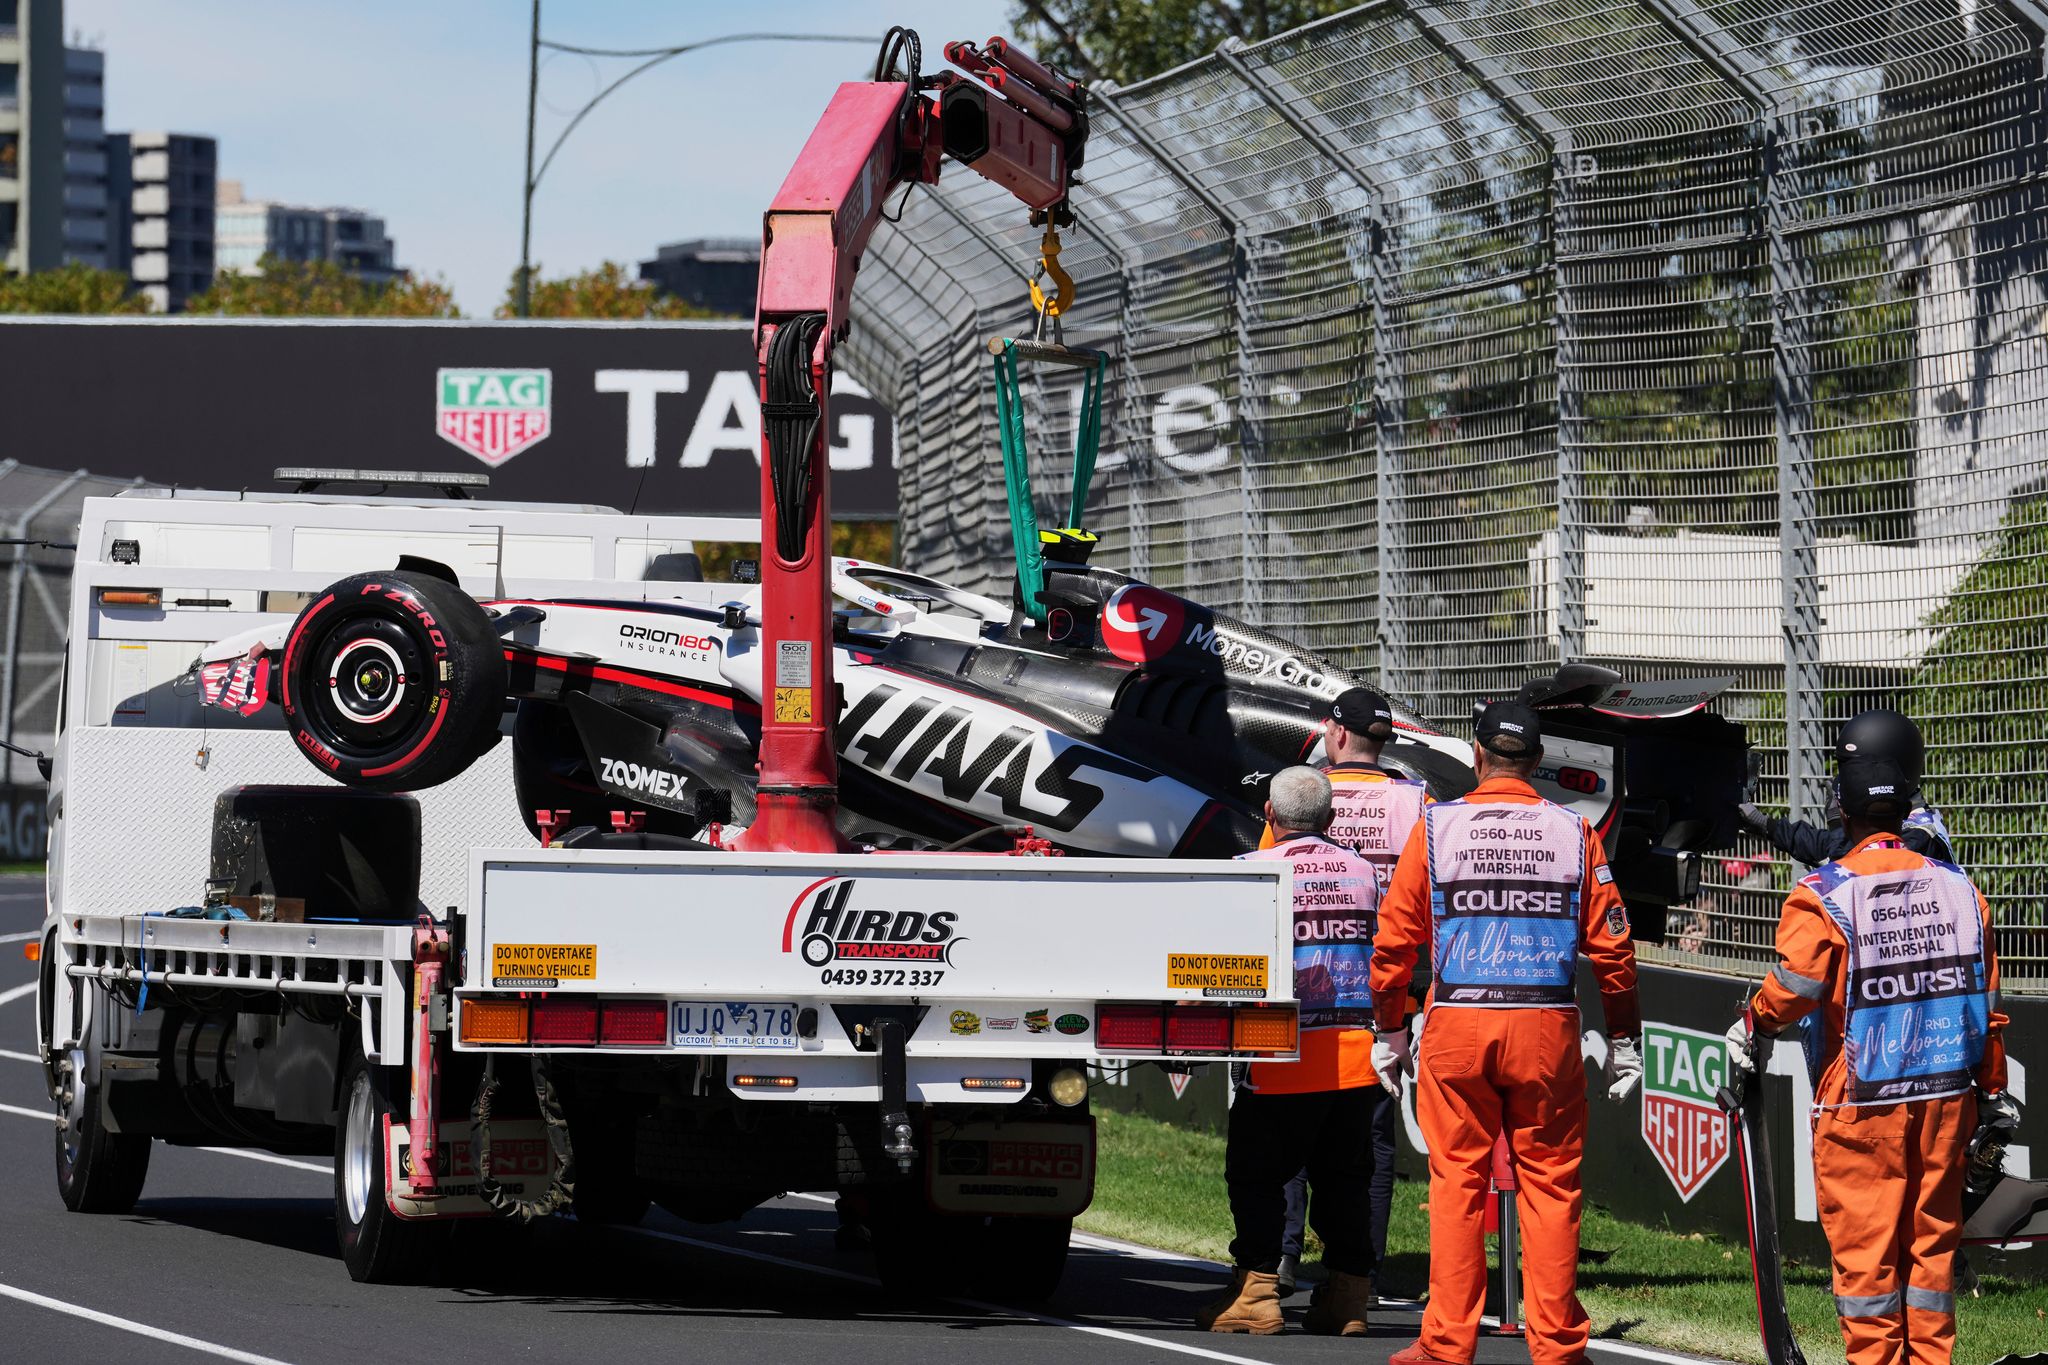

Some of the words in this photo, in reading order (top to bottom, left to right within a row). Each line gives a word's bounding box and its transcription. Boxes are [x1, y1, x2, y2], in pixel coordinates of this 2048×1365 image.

[447, 376, 539, 406] TAG
[445, 412, 544, 457] HEUER
[361, 584, 382, 596] P
[385, 588, 447, 649] ZERO
[619, 624, 713, 651] ORION180
[620, 640, 707, 662] INSURANCE
[1626, 696, 1663, 706] TOYOTA
[1665, 694, 1697, 705] GAZOO
[297, 728, 341, 772] PIRELLI
[838, 683, 1166, 833] HAAS
[600, 756, 688, 801] ZOOMEX
[1334, 807, 1386, 819] 82-AUS
[1326, 826, 1385, 838] ECOVERY
[1470, 828, 1543, 841] 0560-AUS
[1334, 838, 1389, 850] SONNEL
[1455, 848, 1555, 862] INTERVENTION
[1473, 862, 1540, 876] MARSHAL
[1304, 881, 1340, 892] CRANE
[1293, 893, 1356, 906] PERSONNEL
[1452, 889, 1562, 913] COURSE
[801, 880, 959, 943] HIRDS
[1871, 901, 1940, 922] 0564-AUS
[1293, 920, 1367, 941] OURSE
[1858, 922, 1957, 947] INTERVENTION
[496, 947, 511, 959] DO
[513, 947, 534, 959] NOT
[537, 947, 593, 960] OVERTAKE
[837, 944, 944, 959] TRANSPORT
[1445, 921, 1568, 972] Melbourne
[1879, 939, 1945, 960] MARSHAL
[498, 964, 544, 975] TURNING
[546, 964, 590, 976] VEHICLE
[1171, 957, 1186, 969] DO
[1188, 957, 1208, 970] NOT
[1210, 957, 1264, 970] OVERTAKE
[1294, 949, 1369, 989] elbourn
[821, 969, 868, 986] 0439
[871, 969, 906, 986] 372
[909, 970, 945, 986] 337
[1173, 973, 1217, 986] TURNING
[1219, 974, 1263, 987] VEHICLE
[1861, 967, 1967, 1001] COURSE
[1488, 990, 1505, 999] FIA
[678, 1007, 725, 1035] UJQ
[746, 1008, 792, 1036] 378
[725, 1036, 739, 1044] THE
[769, 1037, 779, 1045] TO
[1648, 1034, 1721, 1099] TAG
[992, 1144, 1082, 1158] PRESTIGE
[1648, 1100, 1725, 1188] HEUER
[454, 1154, 545, 1171] HNO
[992, 1158, 1080, 1176] HINO
